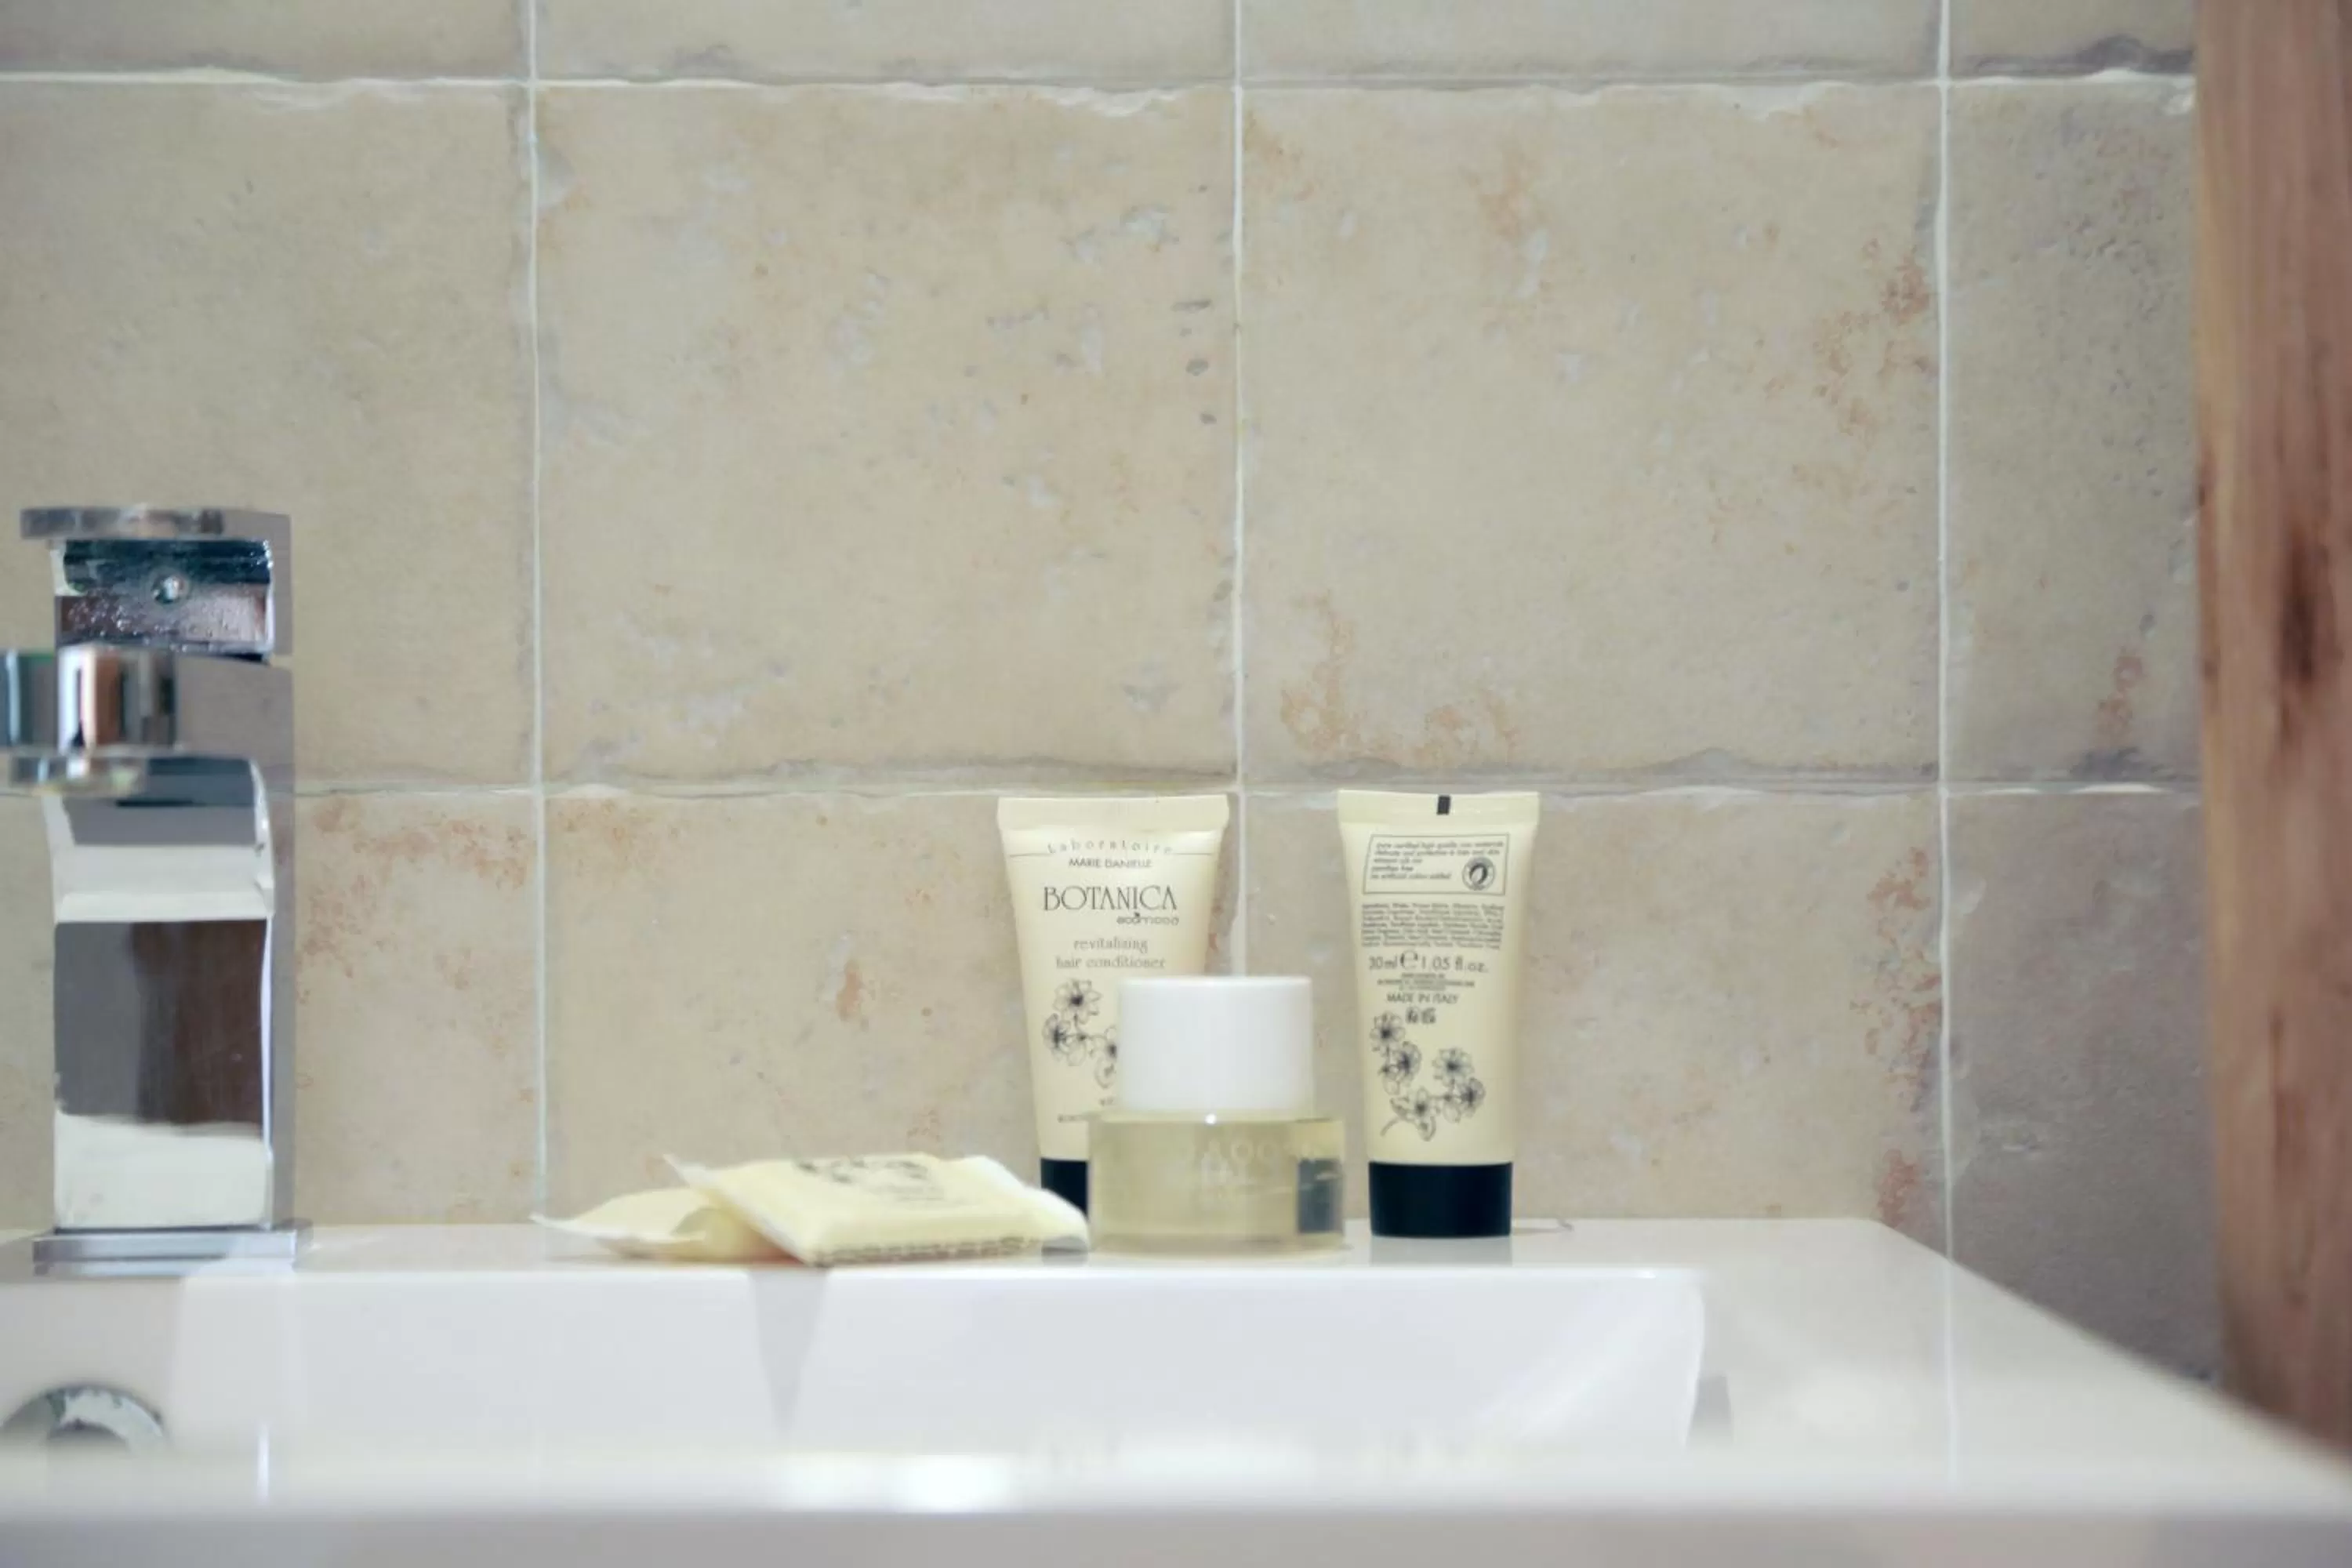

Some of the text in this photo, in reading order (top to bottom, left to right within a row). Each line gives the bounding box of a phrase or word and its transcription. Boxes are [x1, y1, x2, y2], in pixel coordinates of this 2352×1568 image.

[1069, 858, 1152, 869] MARIE DANIELLE
[1044, 885, 1178, 911] BOTANICA
[1056, 956, 1165, 969] hair conditioner
[1387, 993, 1460, 1004] MADE IN ITALY
